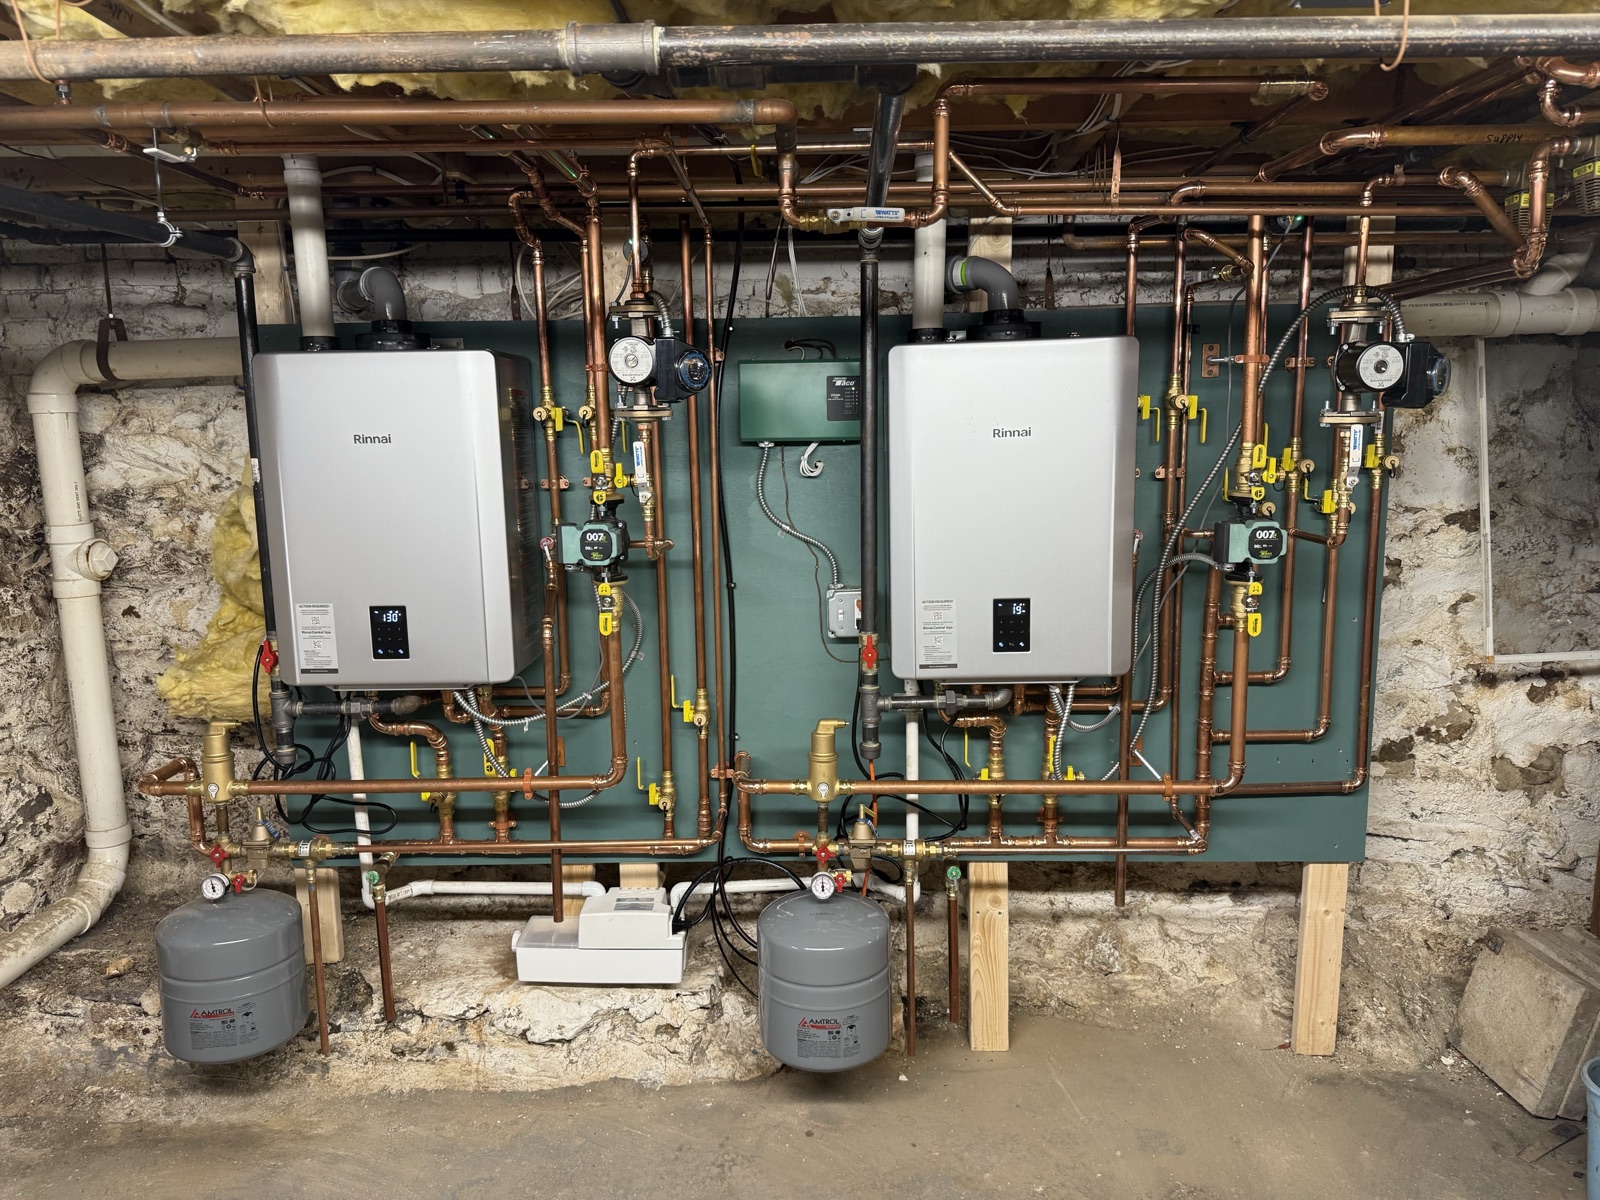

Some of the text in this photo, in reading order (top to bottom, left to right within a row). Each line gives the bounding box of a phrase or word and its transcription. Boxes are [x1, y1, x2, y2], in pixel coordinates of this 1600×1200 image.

[993, 426, 1031, 438] Rinnai
[353, 433, 391, 444] Rinnai
[200, 1007, 233, 1016] AMTROL
